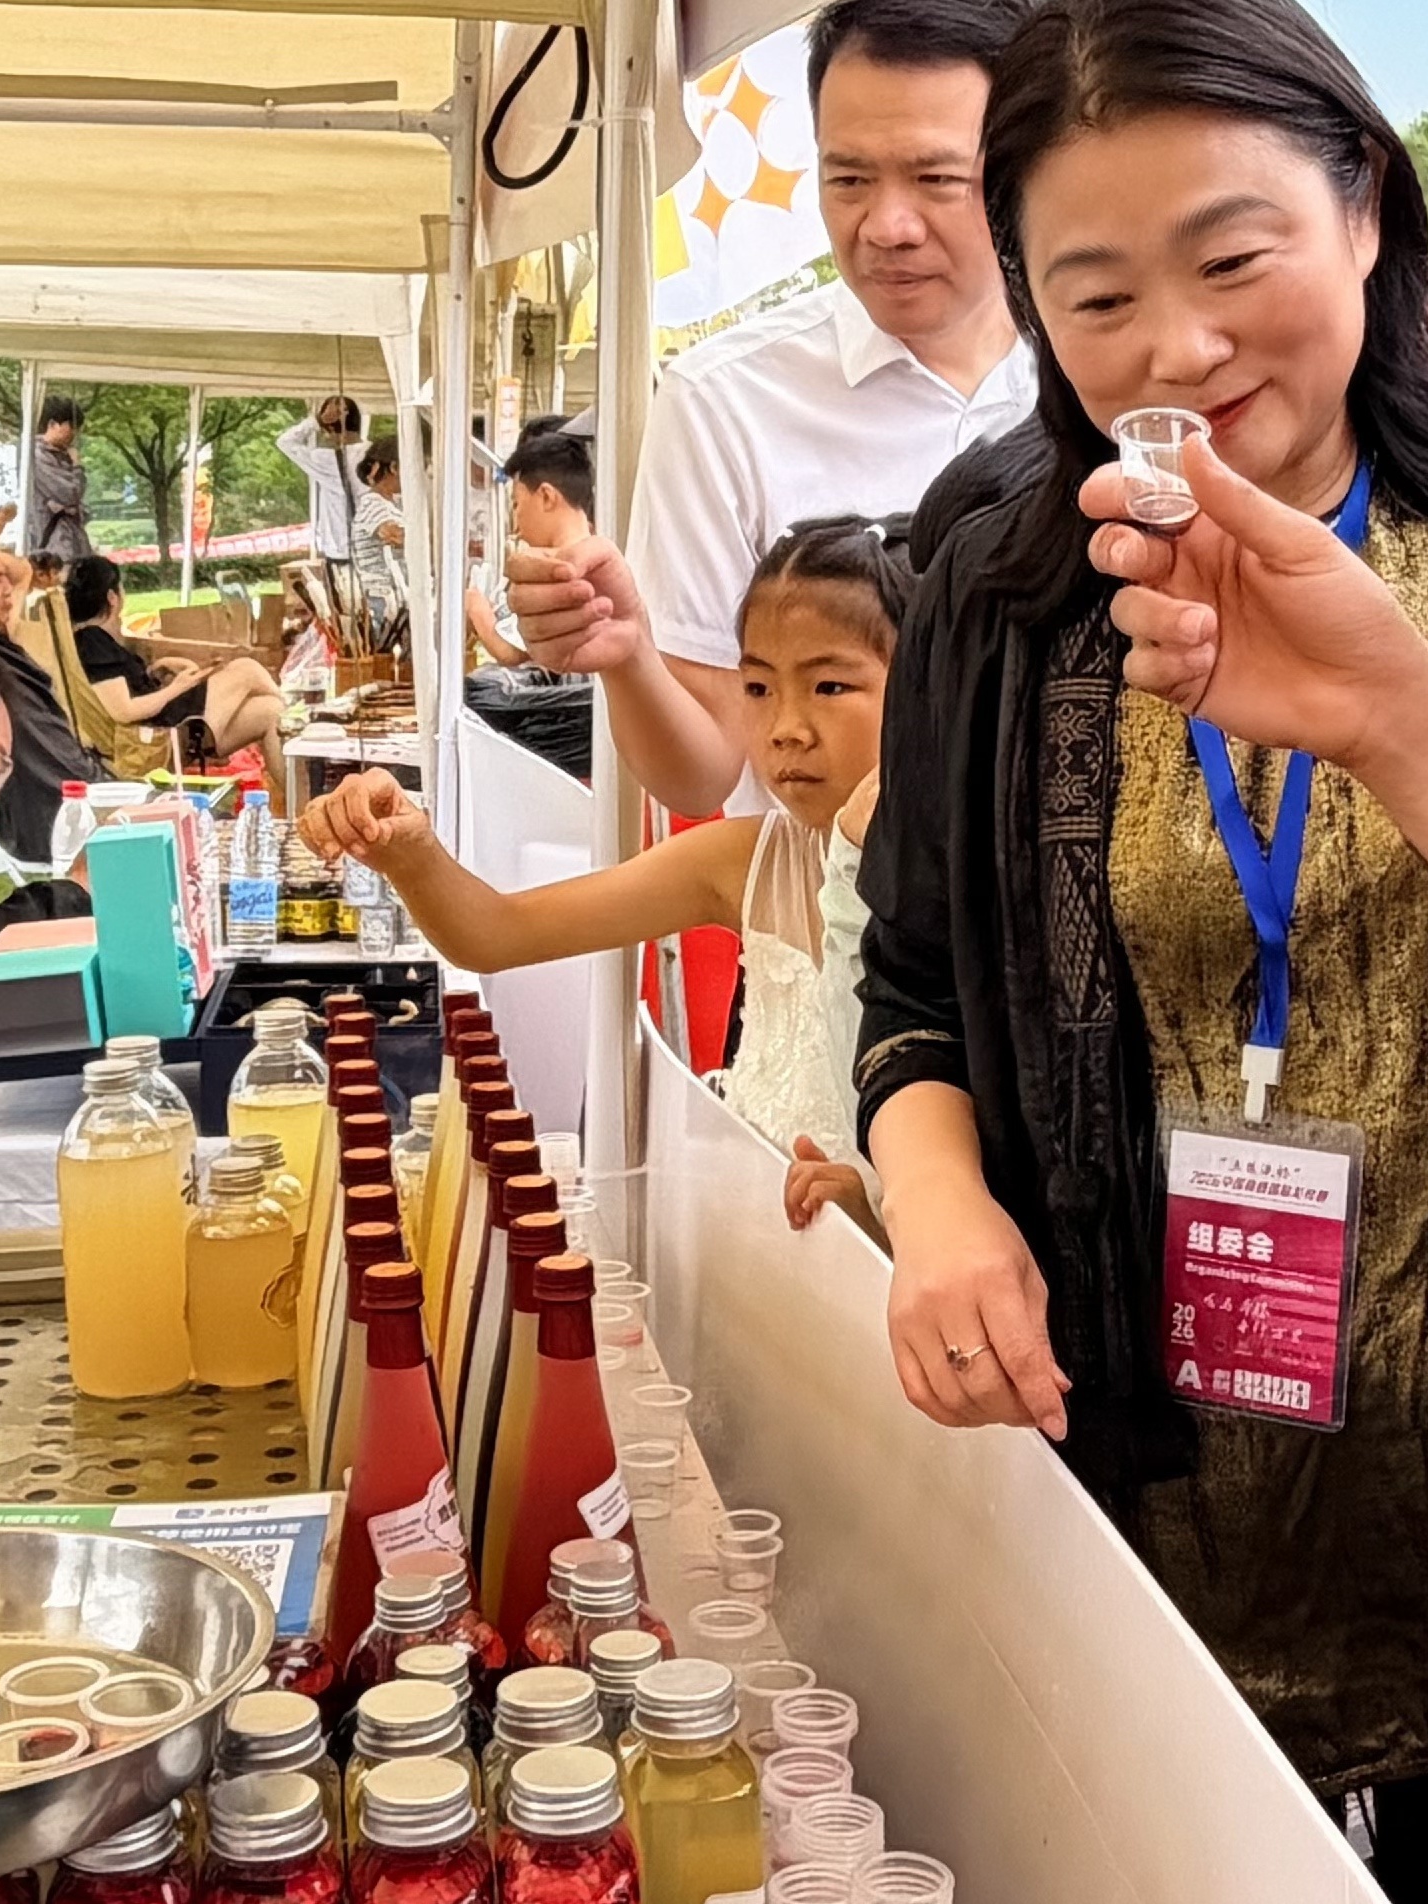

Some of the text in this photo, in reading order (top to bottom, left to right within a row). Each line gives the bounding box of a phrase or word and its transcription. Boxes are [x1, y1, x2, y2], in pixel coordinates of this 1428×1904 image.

[1186, 1221, 1274, 1263] 组委会
[1174, 1359, 1203, 1391] A
